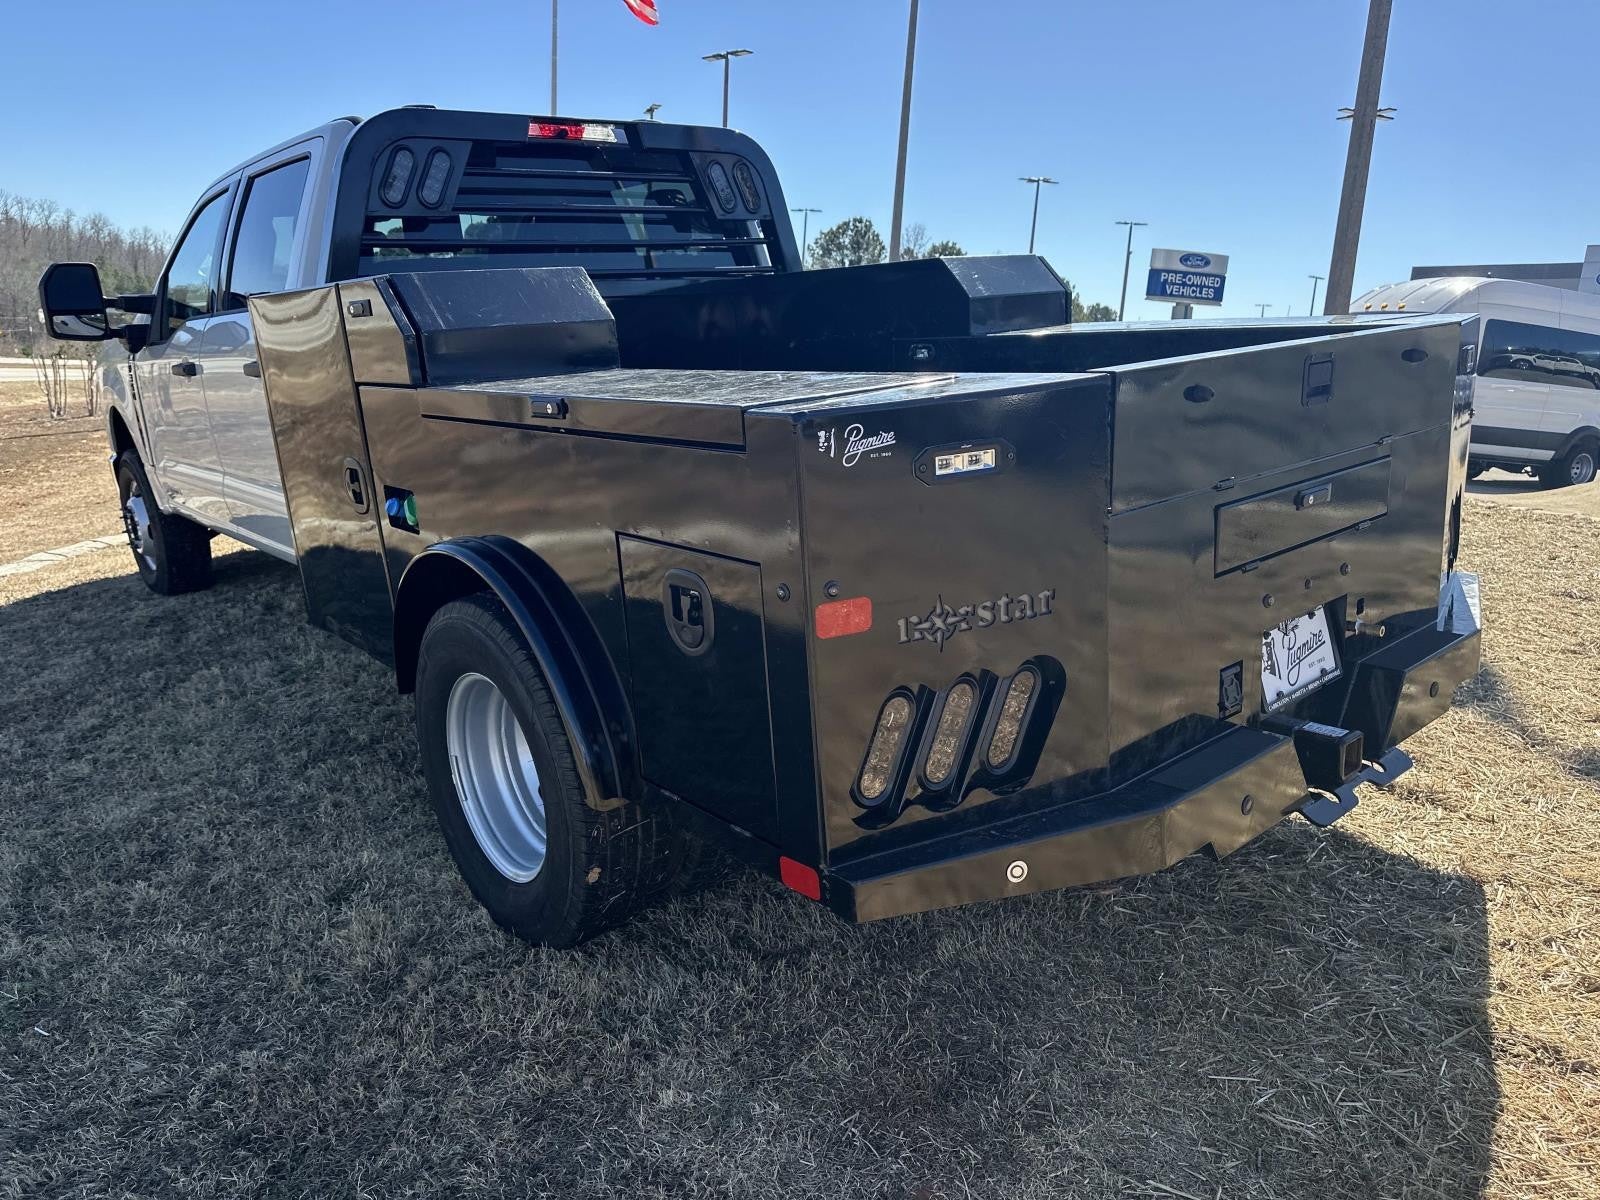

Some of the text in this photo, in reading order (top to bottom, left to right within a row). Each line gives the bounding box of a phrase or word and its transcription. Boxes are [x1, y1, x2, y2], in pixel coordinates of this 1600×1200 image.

[1183, 254, 1207, 267] Ford
[1160, 272, 1221, 288] PRE-OWNED
[1165, 284, 1215, 299] VEHICLES
[842, 423, 896, 467] Pugmire
[1281, 629, 1326, 687] Pugmire
